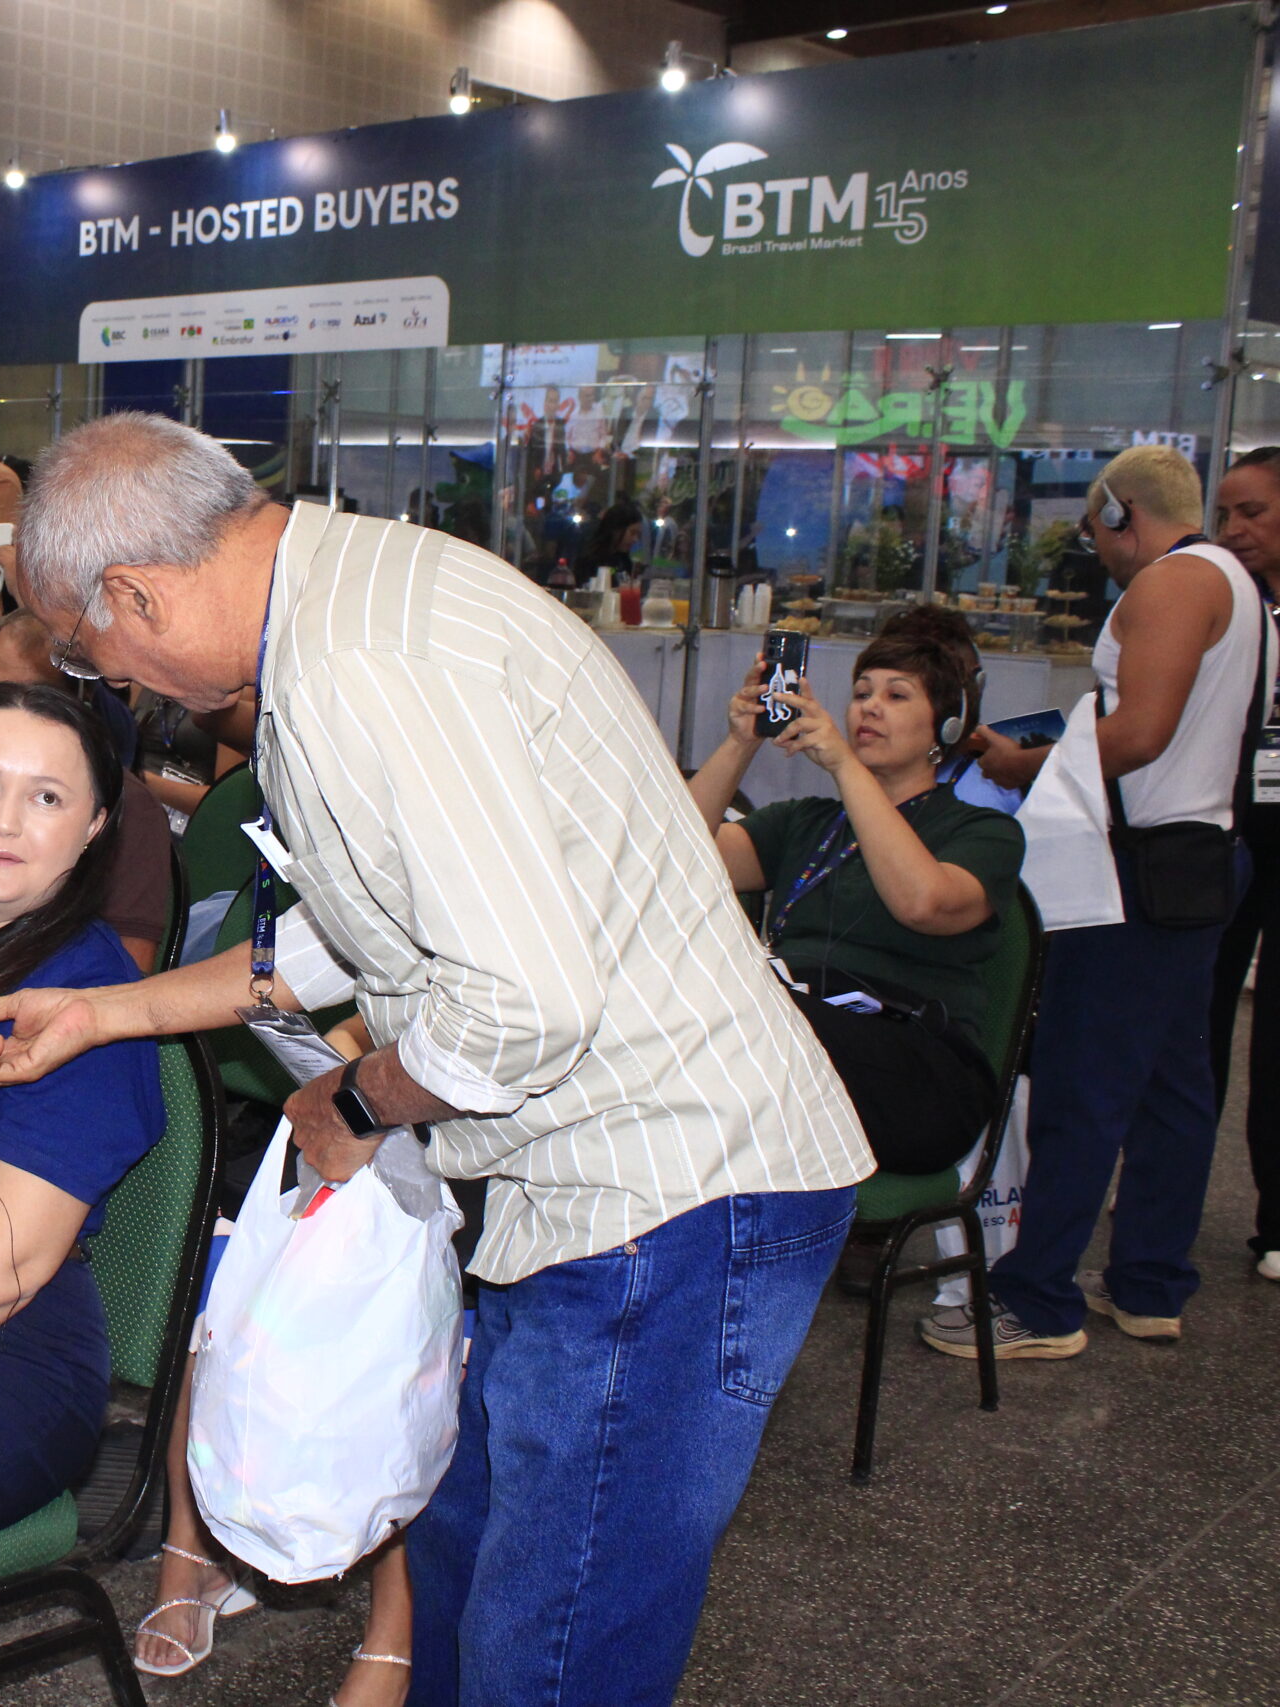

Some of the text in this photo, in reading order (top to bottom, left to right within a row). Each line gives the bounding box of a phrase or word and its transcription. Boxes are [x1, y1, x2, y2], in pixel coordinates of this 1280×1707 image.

[900, 169, 968, 193] Anos
[79, 215, 140, 256] BTM
[171, 196, 304, 247] HOSTED
[315, 177, 459, 232] BUYERS
[722, 172, 869, 240] BTM
[873, 181, 927, 245] 15
[722, 236, 862, 256] Brazil Travel Market
[354, 314, 376, 326] Azul
[978, 1187, 1023, 1208] RLA
